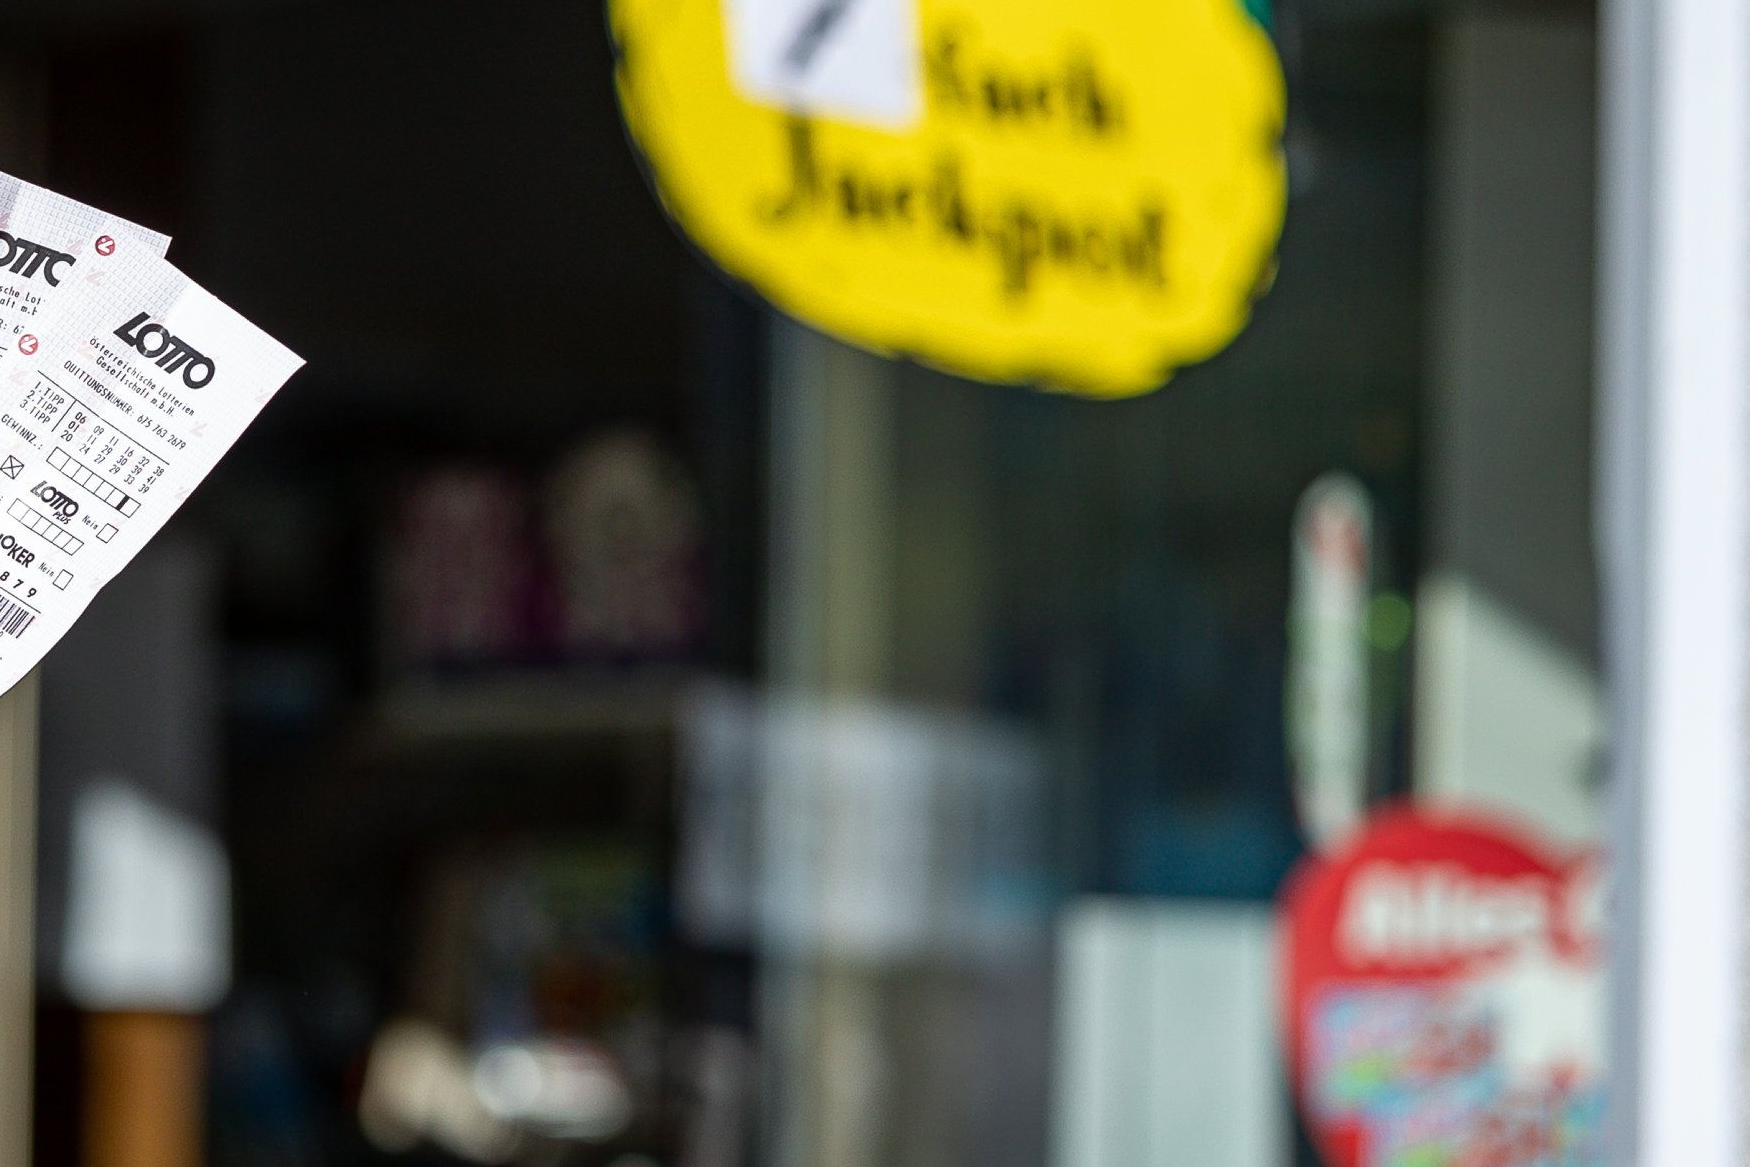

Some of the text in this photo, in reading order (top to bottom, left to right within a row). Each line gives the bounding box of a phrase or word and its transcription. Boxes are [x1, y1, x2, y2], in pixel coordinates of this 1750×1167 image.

[89, 335, 195, 417] Österreichische Lotterien
[95, 355, 175, 417] Gesellschaft m.b.H.
[112, 311, 216, 390] LOTTO
[1, 413, 43, 450] GEWINNZ.:
[26, 390, 58, 414] 2.TIPP
[67, 420, 80, 433] 01
[86, 434, 97, 445] 11
[101, 444, 113, 456] 29
[116, 455, 128, 466] 30
[131, 465, 143, 476] 39
[34, 381, 65, 406] 1.TIPP
[74, 411, 86, 425] 06
[109, 436, 119, 447] 11
[124, 446, 134, 458] 16
[138, 456, 150, 467] 32
[153, 466, 165, 477] 38
[63, 360, 187, 450] QUITTUNGSNUMMER: 675 763 2679
[19, 399, 150, 495] 3.TIPP 20 24 27 29 33 39
[30, 480, 80, 518] LOTTO
[81, 514, 99, 530] Nein
[52, 511, 72, 525] PLUS
